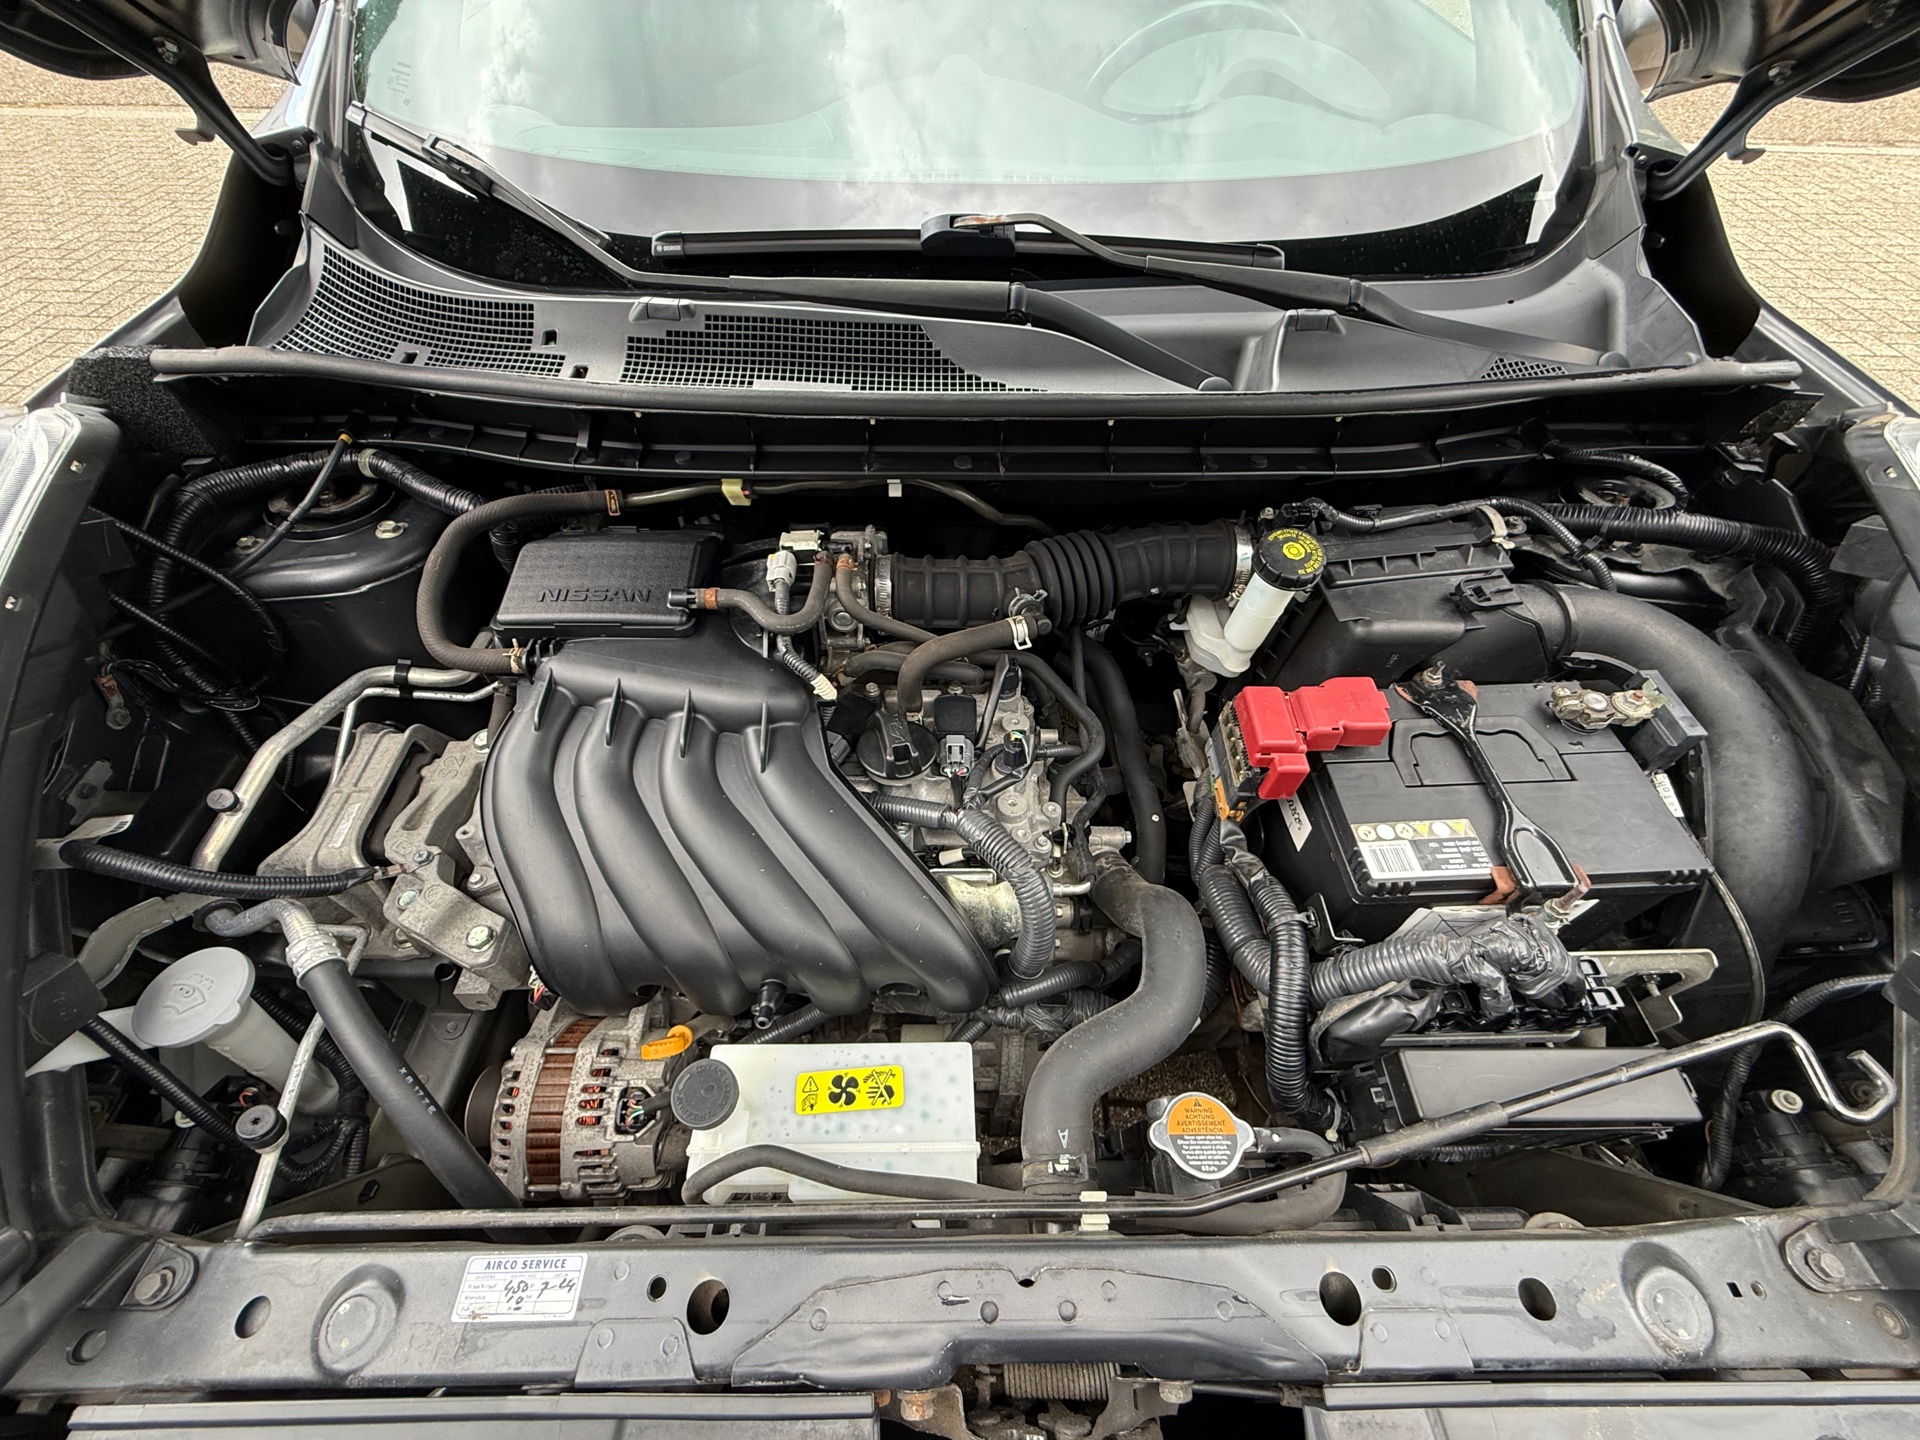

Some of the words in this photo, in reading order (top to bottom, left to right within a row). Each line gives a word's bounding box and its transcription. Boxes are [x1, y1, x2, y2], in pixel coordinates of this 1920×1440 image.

[538, 588, 652, 602] NISSAN
[484, 1260, 517, 1270] AIRCO
[521, 1259, 567, 1269] SERVICE
